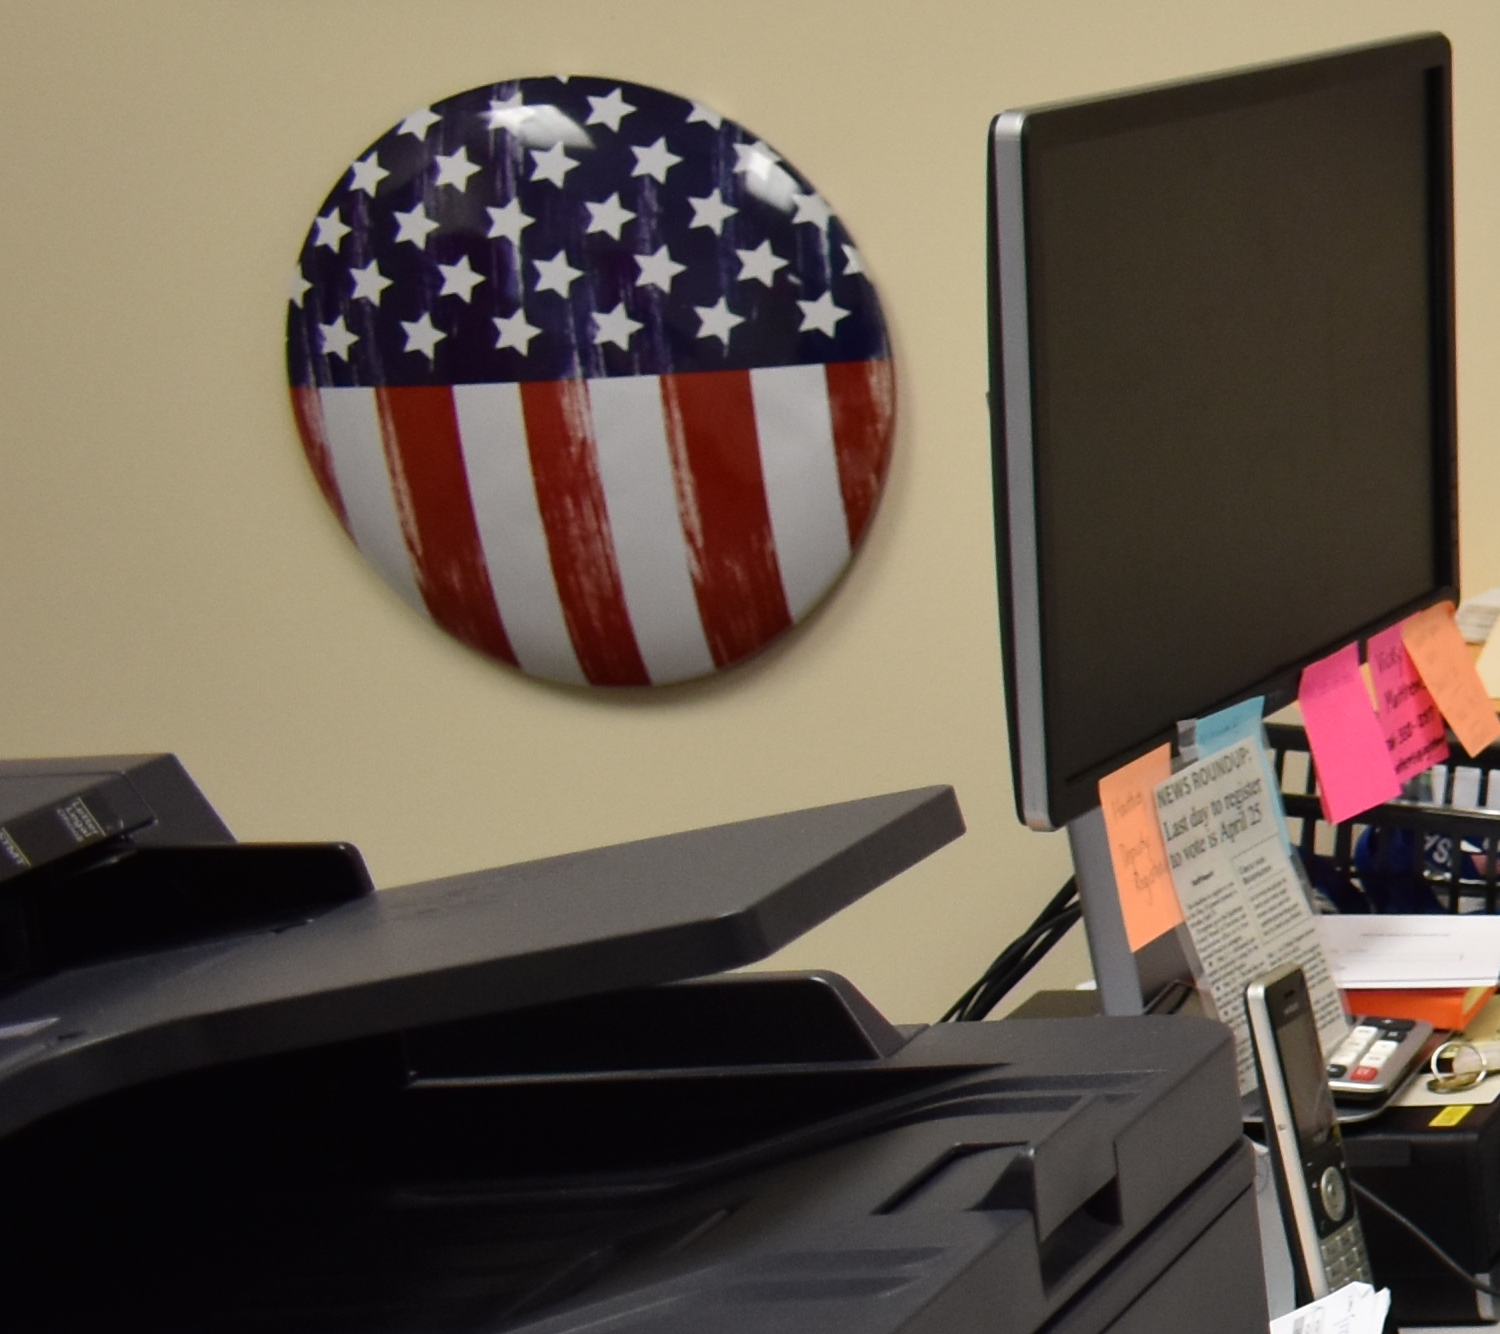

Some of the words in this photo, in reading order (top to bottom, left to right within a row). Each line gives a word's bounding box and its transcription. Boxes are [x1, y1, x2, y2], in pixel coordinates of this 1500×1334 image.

[1156, 779, 1192, 808] NEWS
[1163, 816, 1190, 844] Last
[1190, 805, 1211, 832] day
[1211, 796, 1225, 815] to
[1224, 777, 1263, 813] register
[1207, 832, 1219, 849] is
[1219, 815, 1250, 846] April
[1249, 802, 1262, 826] 25
